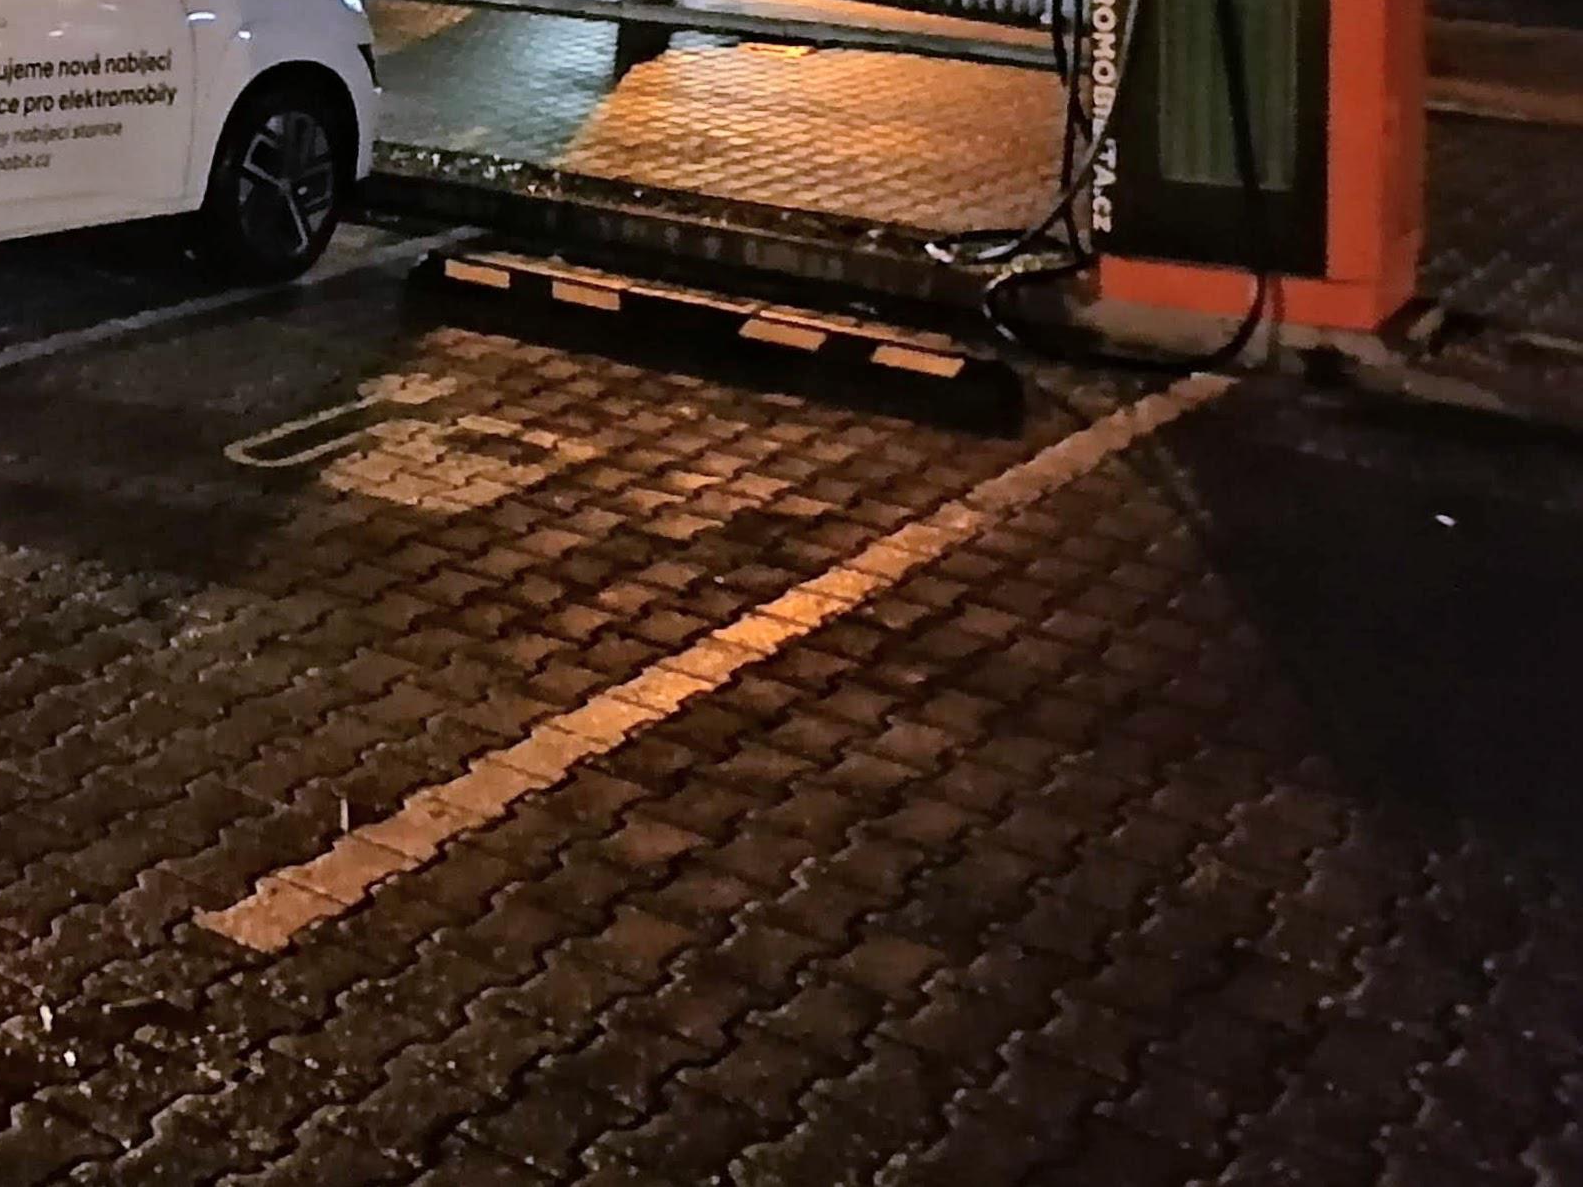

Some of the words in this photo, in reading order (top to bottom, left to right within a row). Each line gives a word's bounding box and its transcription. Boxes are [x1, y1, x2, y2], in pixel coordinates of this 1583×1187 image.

[57, 53, 102, 77] nové
[23, 94, 55, 117] pro
[58, 83, 178, 111] elektromobily
